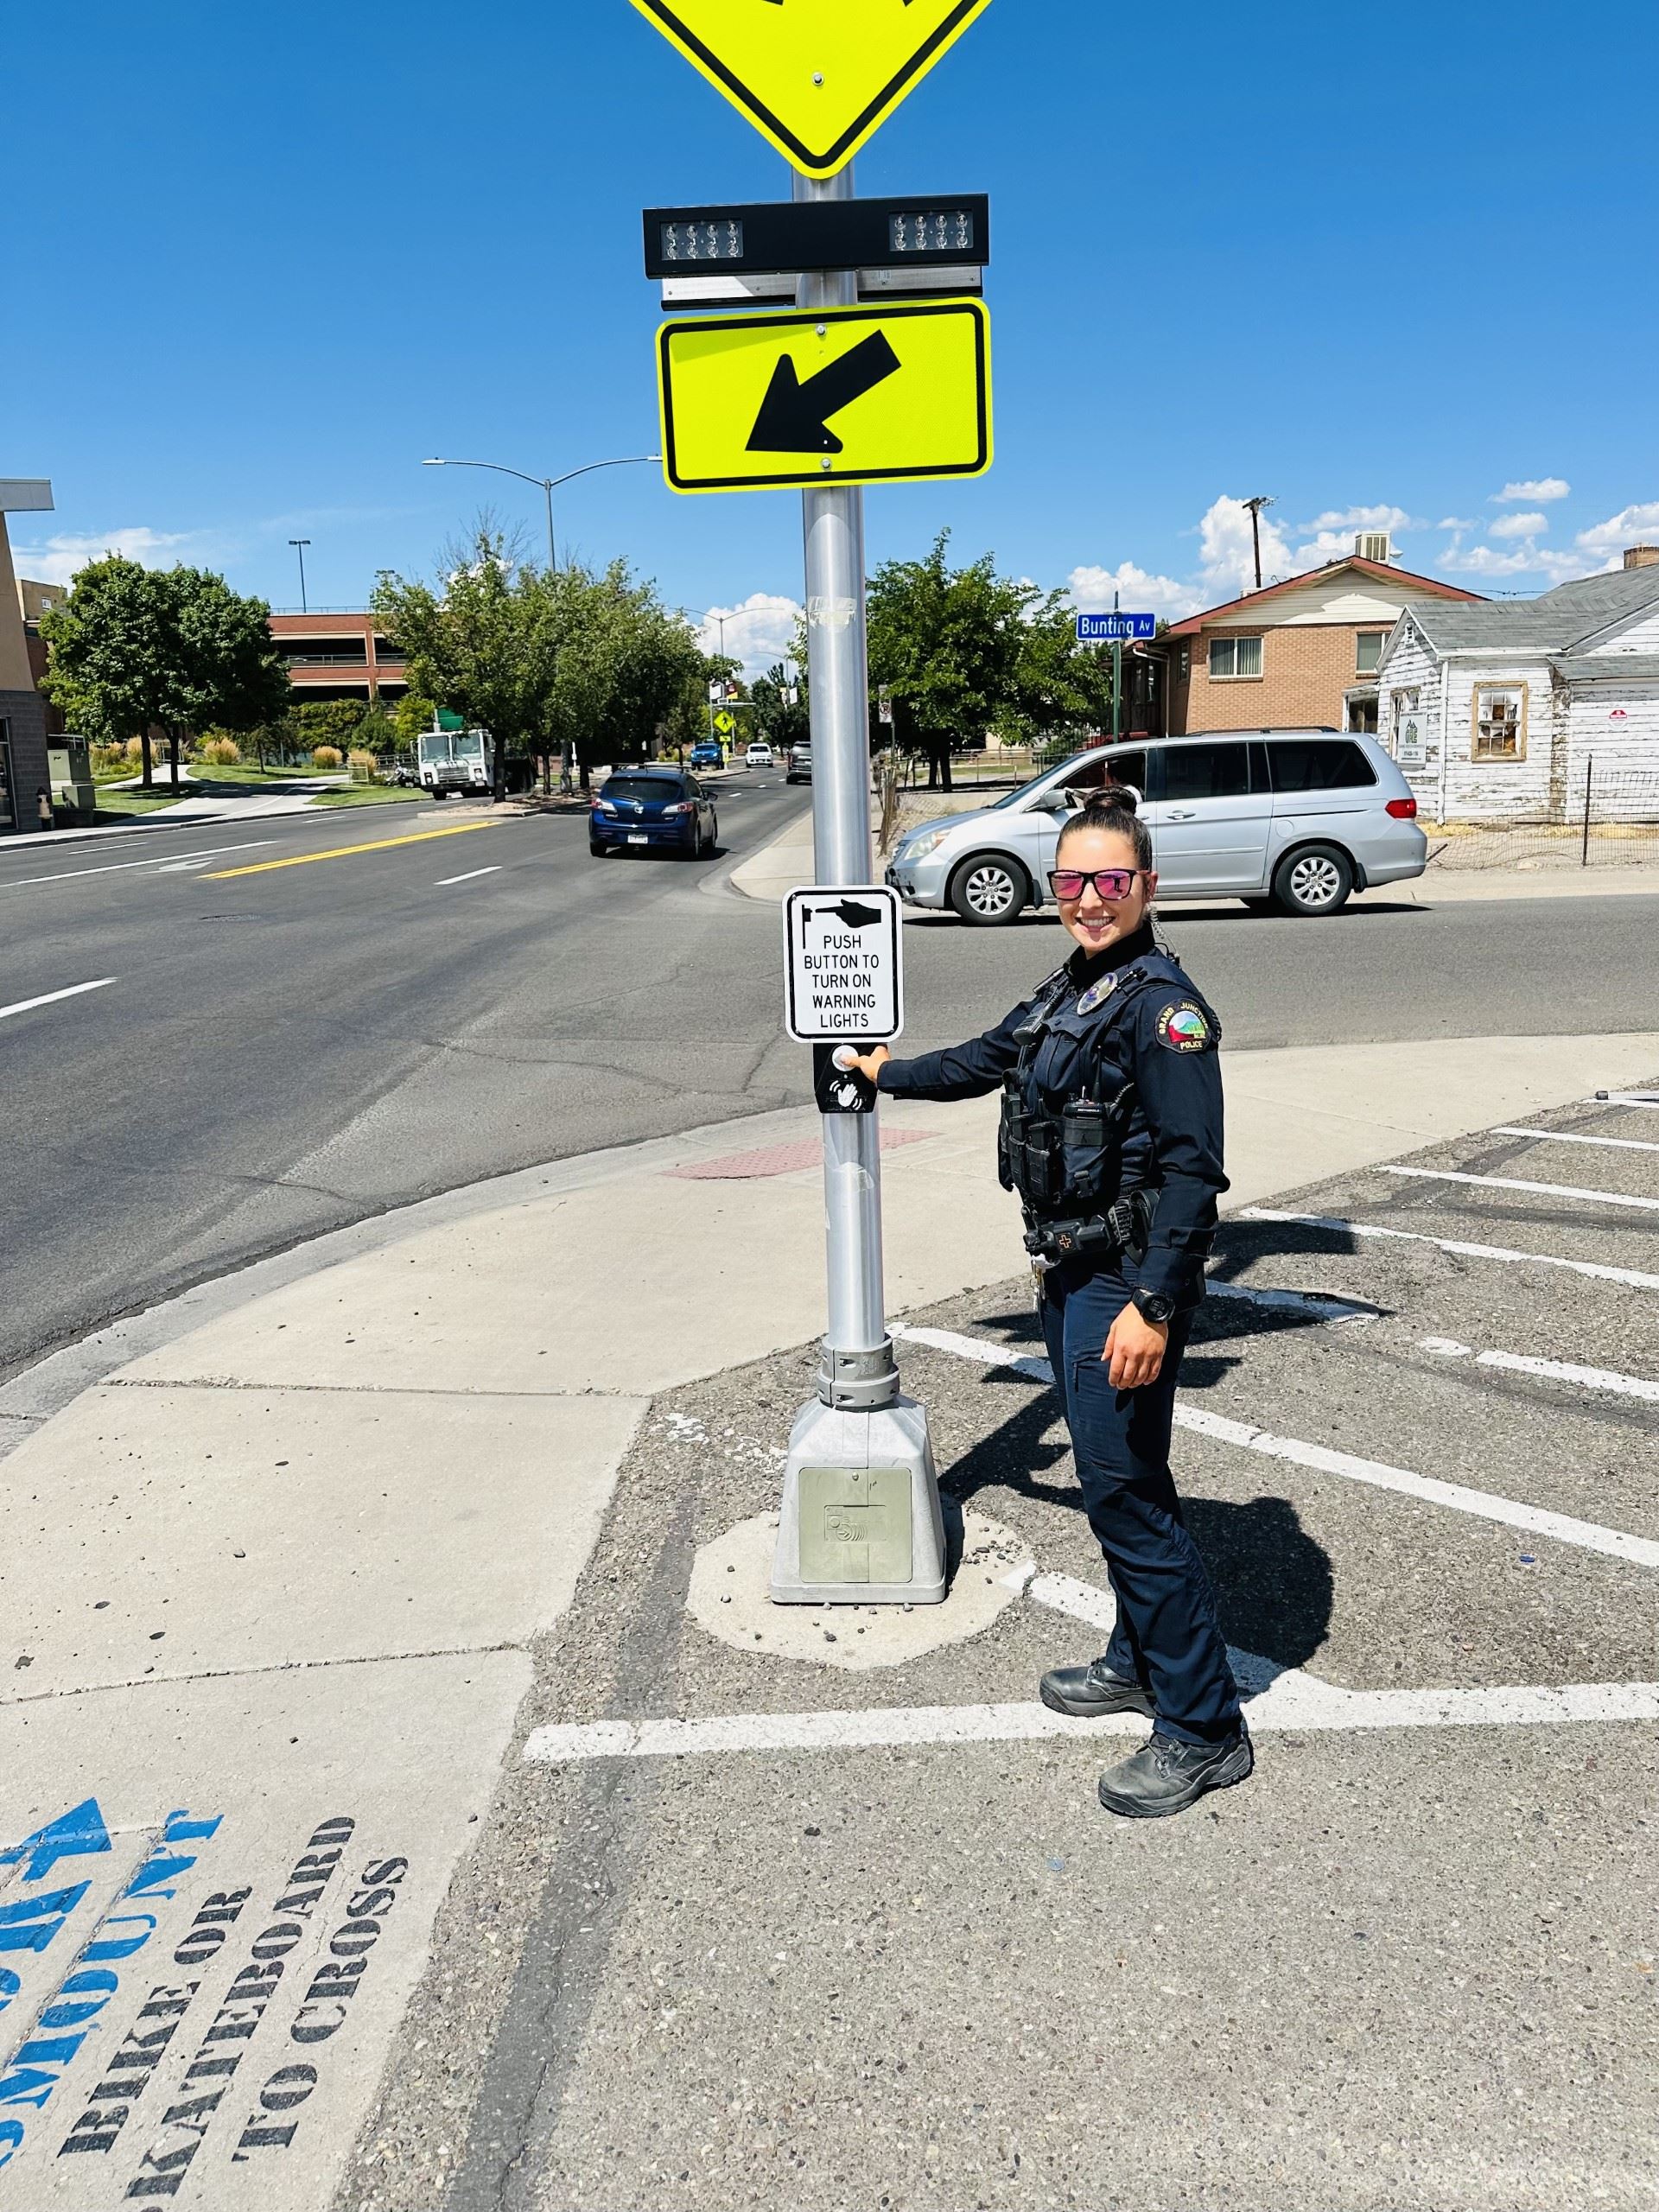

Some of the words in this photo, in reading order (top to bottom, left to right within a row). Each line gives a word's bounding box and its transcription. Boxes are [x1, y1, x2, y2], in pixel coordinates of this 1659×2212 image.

[1081, 616, 1135, 639] Bunting
[1139, 620, 1150, 632] Av
[823, 935, 861, 949] PUSH
[804, 955, 858, 969] BUTTON
[862, 954, 880, 969] TO
[811, 974, 849, 988] TURN
[852, 974, 872, 988] ON
[812, 994, 876, 1008] WARNING
[820, 1013, 869, 1028] LIGHTS
[1159, 1007, 1175, 1034] GRAND
[1180, 1002, 1209, 1029] JUNCTION
[1179, 1040, 1203, 1051] POLICE
[121, 1816, 356, 2212] KATEBOARD
[232, 2063, 318, 2163] TO
[290, 1856, 409, 2044] CROSS
[56, 1981, 201, 2158] BIKE
[173, 1886, 252, 1965] OR
